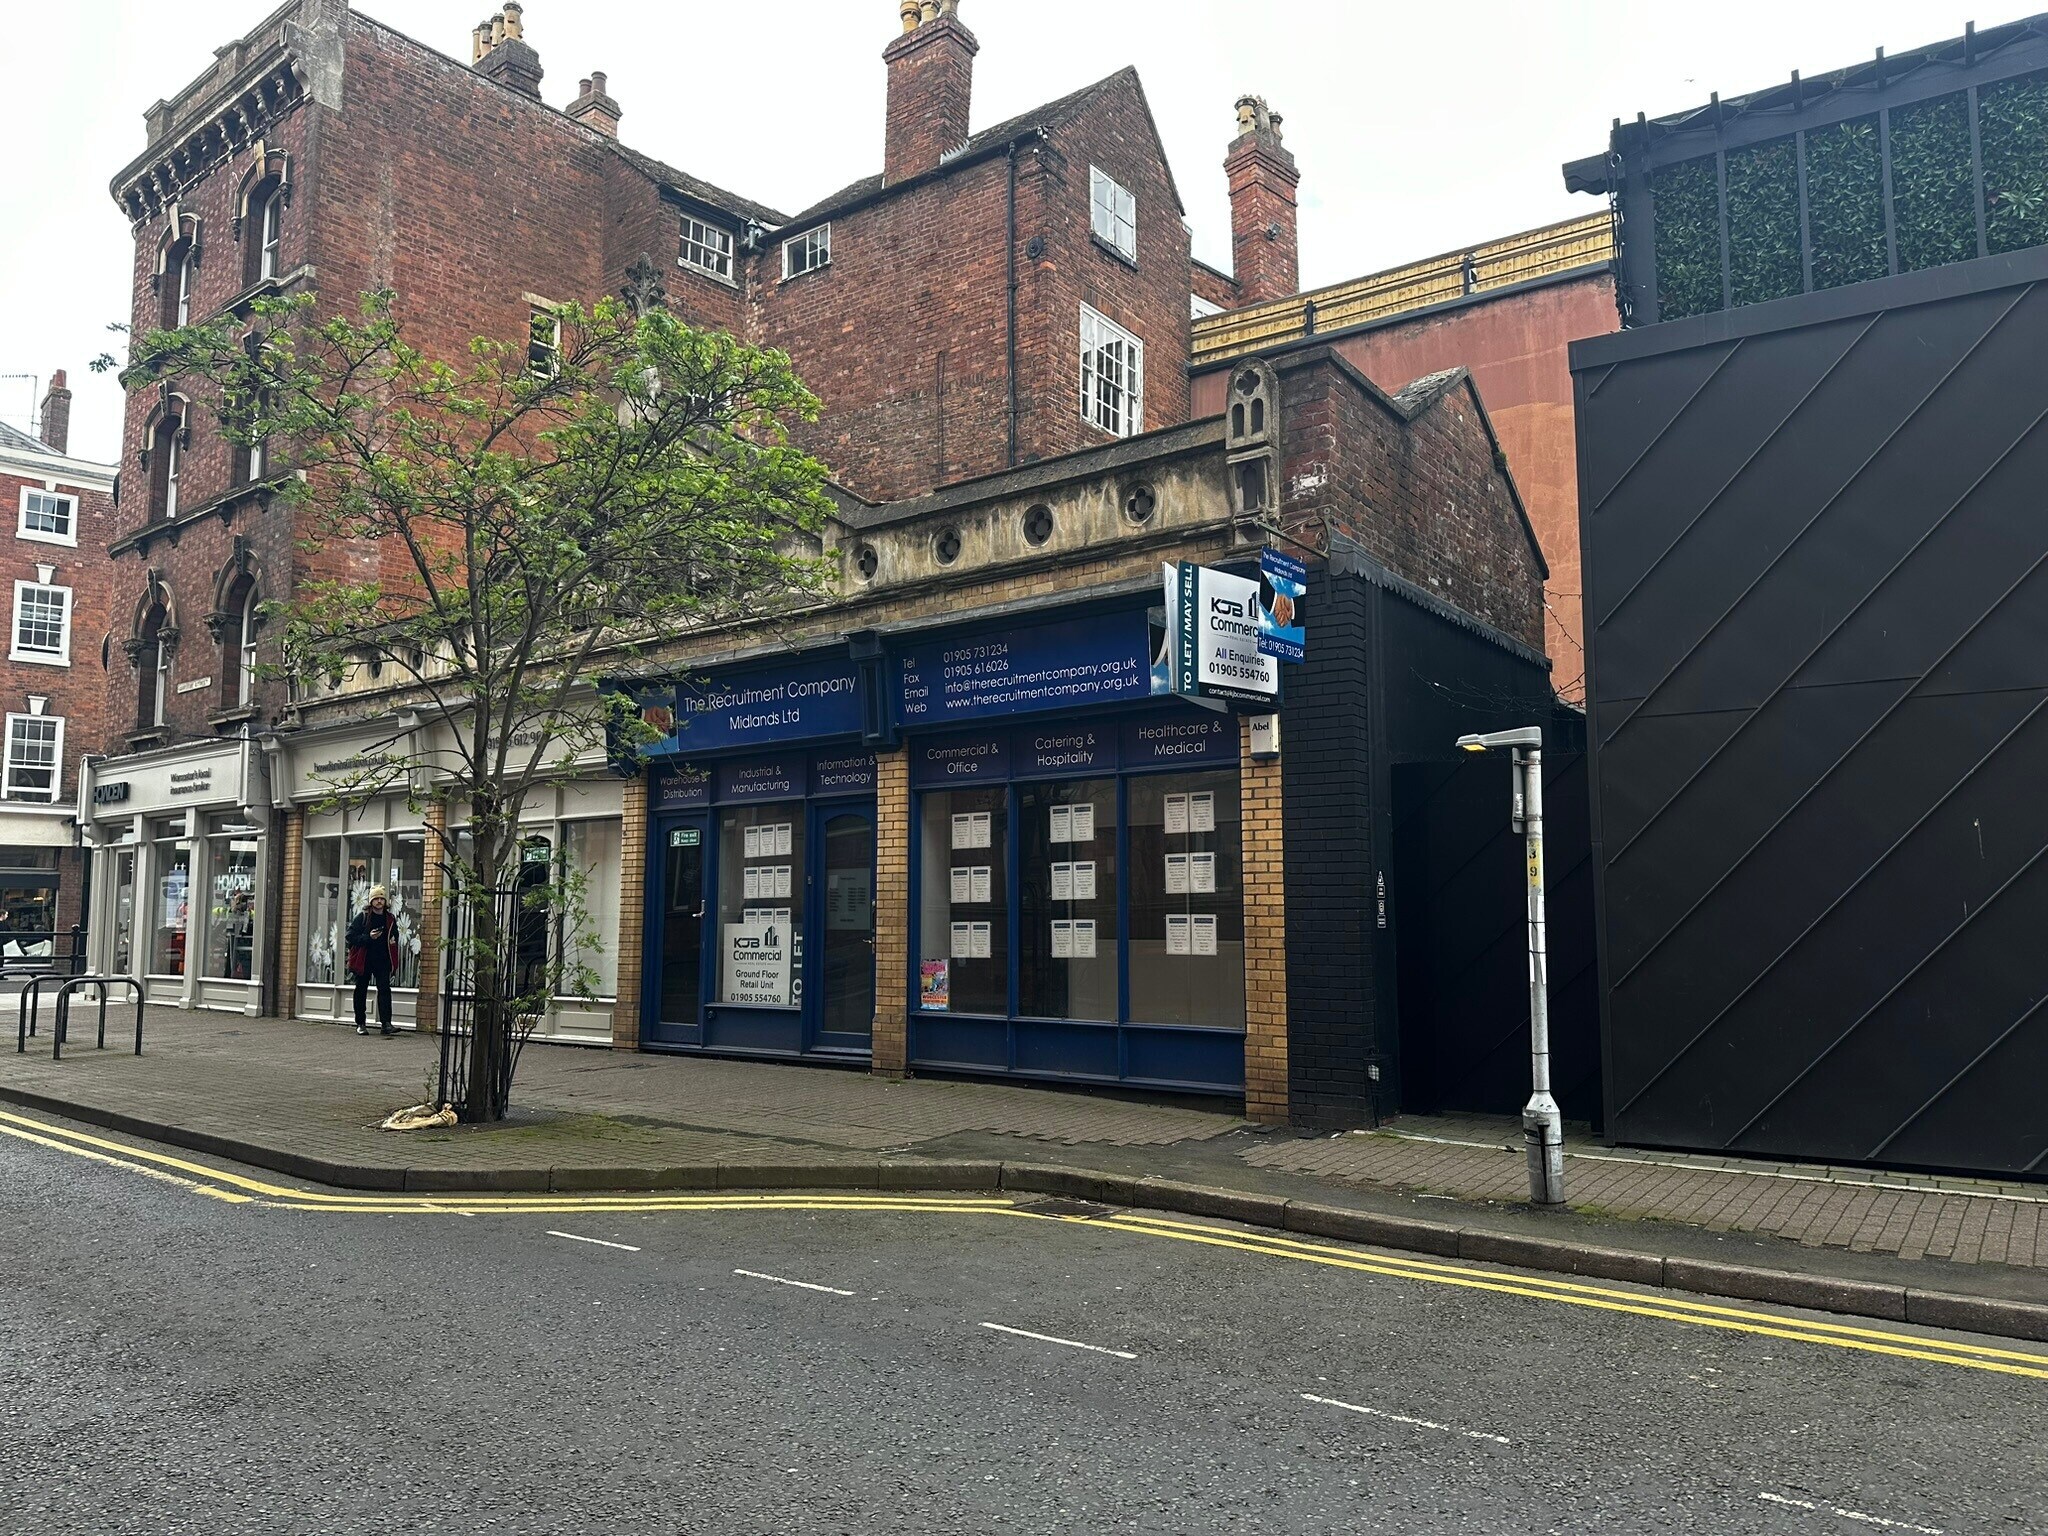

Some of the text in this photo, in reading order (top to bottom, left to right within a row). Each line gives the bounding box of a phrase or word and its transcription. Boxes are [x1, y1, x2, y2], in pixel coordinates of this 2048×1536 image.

[1211, 597, 1243, 618] KJB
[1184, 565, 1193, 692] TO LET / MAY SELL
[1210, 615, 1258, 638] Commerc
[943, 643, 1009, 663] 01905 731234
[1215, 647, 1265, 666] All Enquiries
[1269, 641, 1284, 654] 01905
[1285, 645, 1304, 658] 731234
[903, 658, 916, 669] Tel
[943, 660, 1009, 679] 01905 616026
[903, 673, 920, 684] Fax
[944, 657, 1137, 694] info@therecruitmentcompany.org.uk
[1209, 662, 1270, 683] 01905 554760
[684, 676, 857, 713] The Recruitment Company
[904, 686, 929, 700] Email
[945, 674, 1140, 709] www.therecruitmentcompany.org.uk
[904, 703, 928, 714] Web
[729, 708, 800, 731] Midlands Ltd
[1251, 722, 1270, 732] Abel
[1138, 720, 1222, 739] Healthcare &
[514, 733, 529, 746] 612
[1034, 733, 1096, 752] Catering &
[1154, 739, 1206, 756] Medical
[927, 743, 999, 760] Commercial &
[1037, 750, 1094, 767] Hospitality
[816, 755, 876, 771] Information &
[947, 761, 978, 775] Office
[660, 775, 700, 786] Warehouse
[738, 765, 782, 779] Industrial &
[820, 771, 872, 786] Technology
[94, 782, 124, 803] HOWDEN
[663, 787, 703, 800] Distribution
[731, 779, 790, 794] Manufacturing
[217, 873, 251, 890] HOWDEN
[733, 937, 760, 949] KJB
[733, 949, 782, 961] Commercial
[735, 969, 779, 979] Ground Floor
[740, 979, 774, 989] Retail Unit
[792, 978, 803, 1005] TO
[731, 993, 782, 1003] 01905 554760
